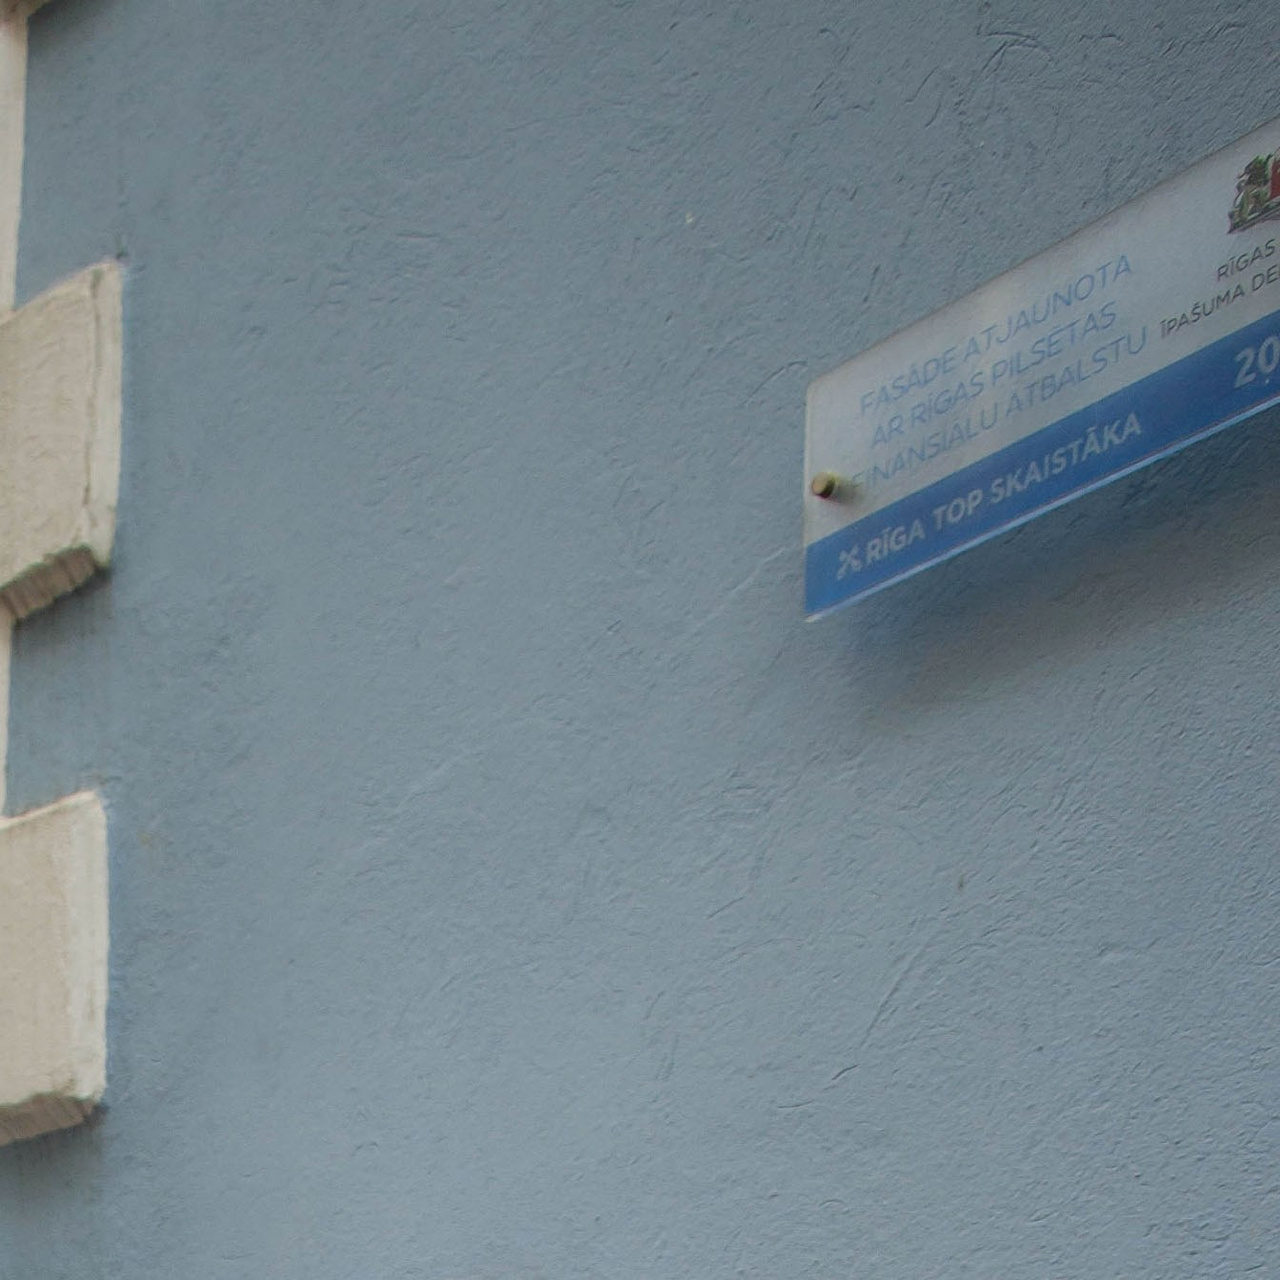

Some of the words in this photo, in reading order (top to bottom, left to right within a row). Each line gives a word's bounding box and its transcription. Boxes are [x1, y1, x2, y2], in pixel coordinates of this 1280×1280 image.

[964, 254, 1133, 363] ATJAUNOTA
[1160, 284, 1246, 338] ĪPAŠUMA
[1252, 263, 1280, 291] DE
[1217, 239, 1275, 282] RĪGAS
[871, 414, 905, 448] AR
[910, 371, 984, 428] RĪGAS
[991, 301, 1117, 387] PILSĒTAS
[1006, 326, 1148, 418] ATBALSTU
[866, 518, 927, 565] RĪGA
[932, 488, 984, 532] TOP
[990, 411, 1142, 504] SKAISTĀKA
